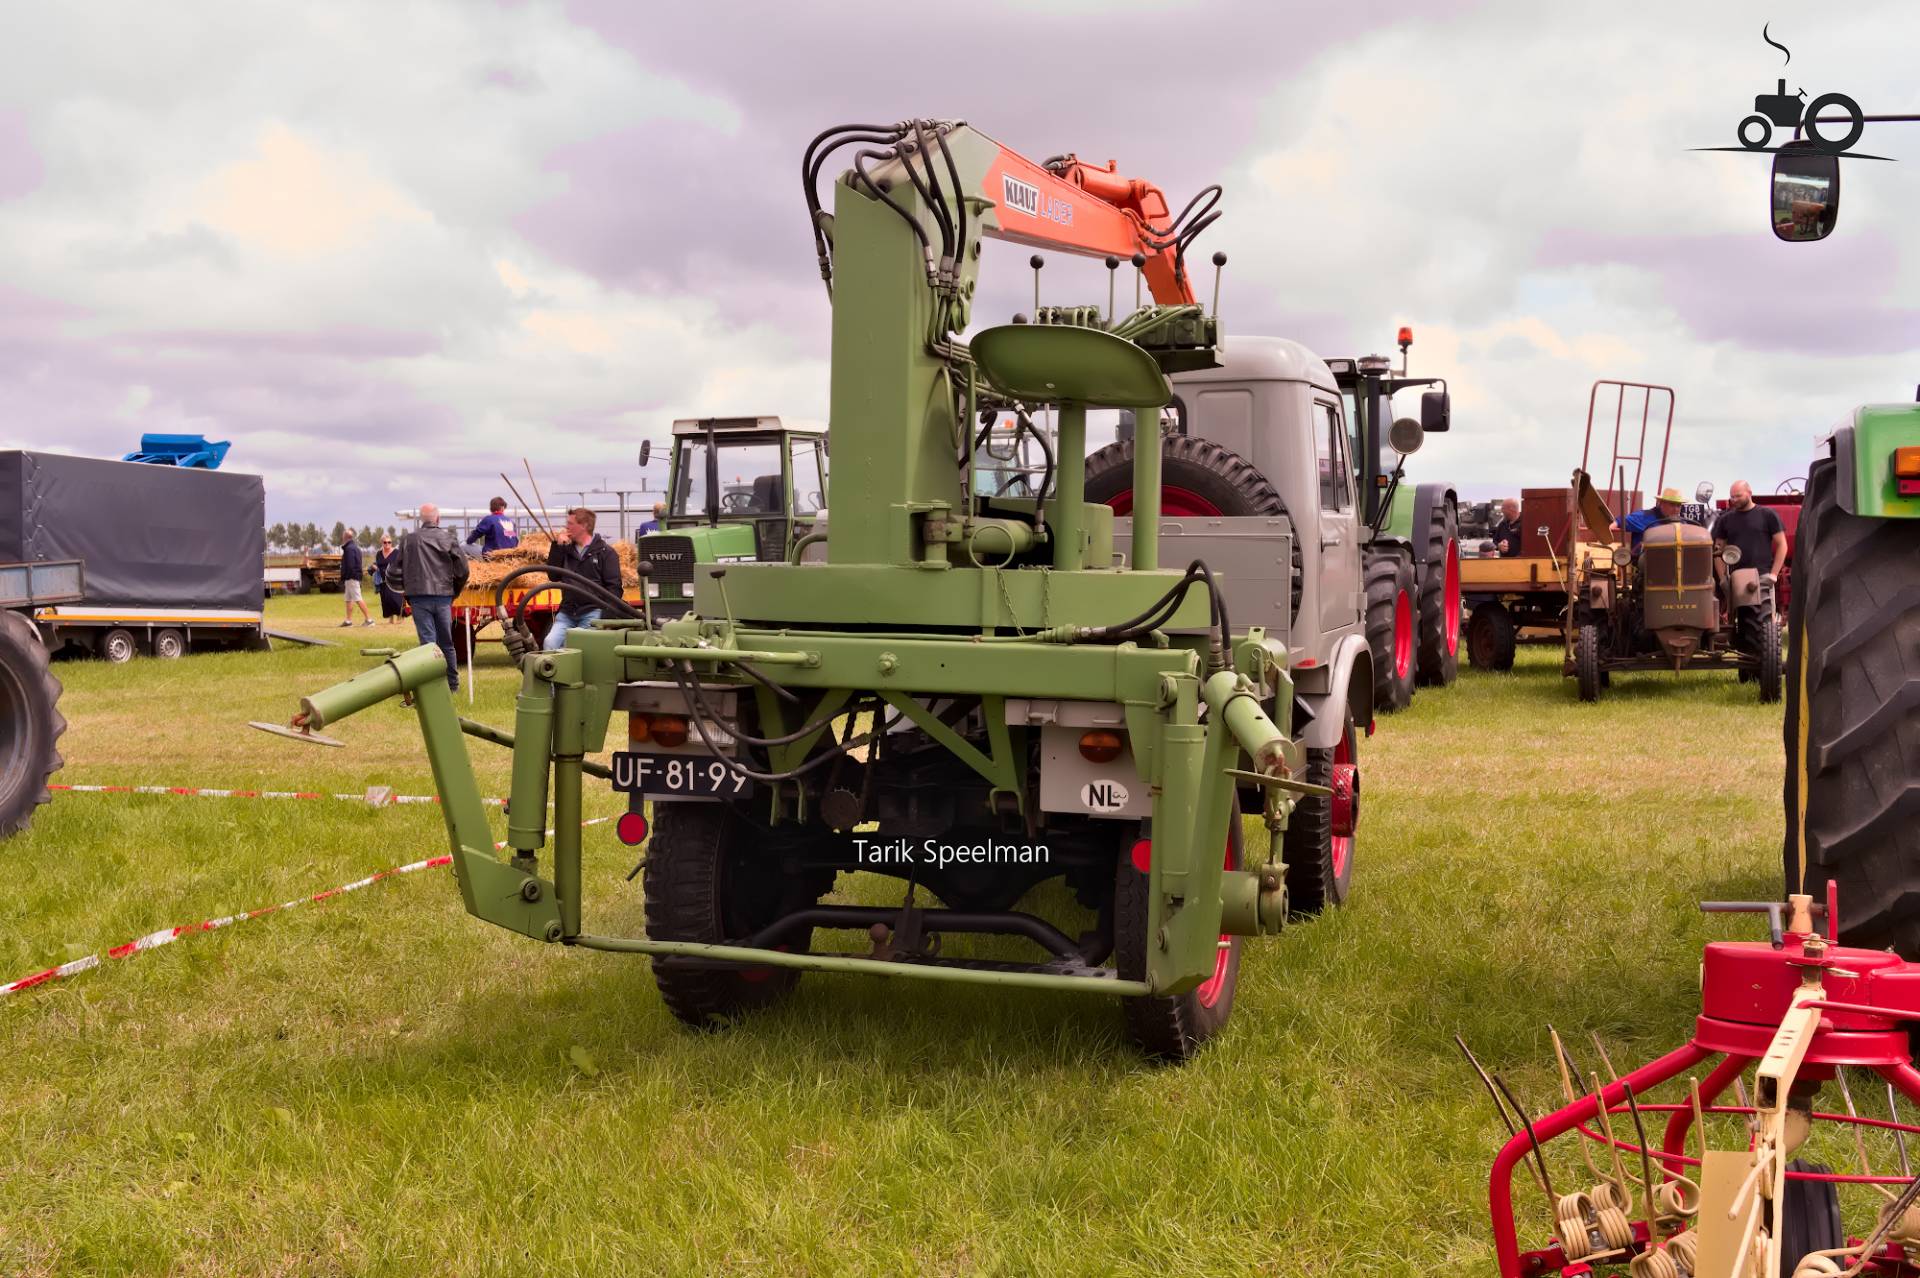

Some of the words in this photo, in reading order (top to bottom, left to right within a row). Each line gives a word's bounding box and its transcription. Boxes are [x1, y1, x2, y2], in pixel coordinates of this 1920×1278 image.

[1004, 179, 1038, 213] KLAUS
[1040, 191, 1073, 225] LADER
[649, 553, 684, 561] FENDT
[616, 757, 748, 793] UF-81-99
[1089, 783, 1120, 807] NL
